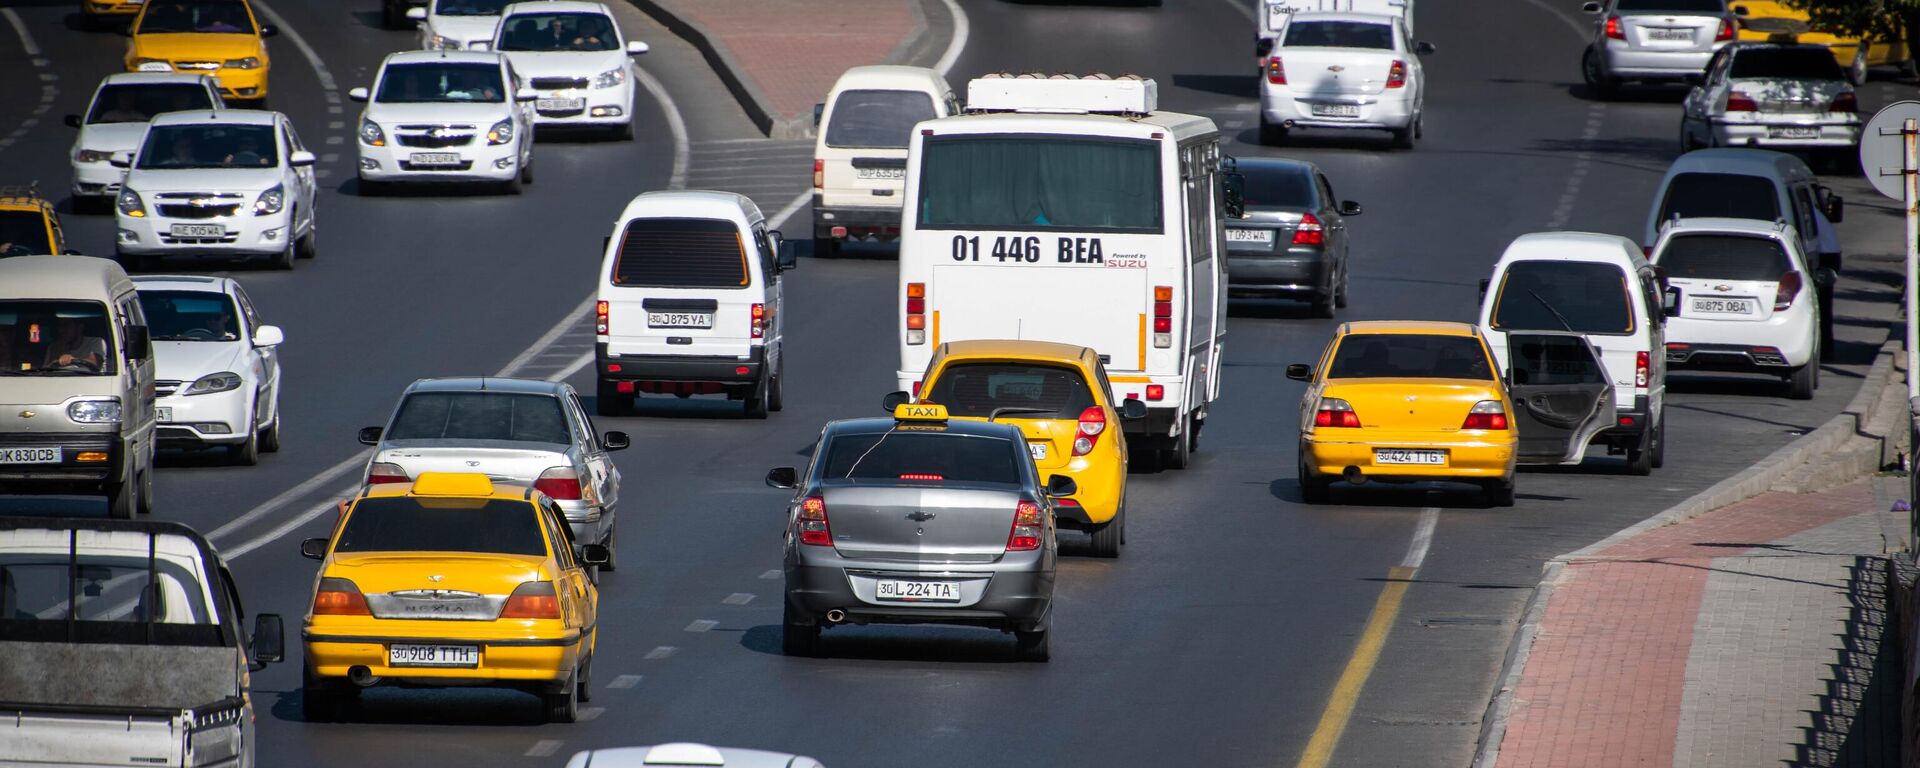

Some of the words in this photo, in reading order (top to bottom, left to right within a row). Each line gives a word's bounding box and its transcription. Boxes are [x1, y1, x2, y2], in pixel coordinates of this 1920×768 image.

[953, 234, 980, 262] 01
[992, 235, 1040, 263] 446
[1058, 237, 1104, 264] BEA
[1104, 260, 1148, 268] ISUZU
[1705, 301, 1724, 311] 875
[651, 315, 661, 323] 30
[671, 315, 689, 325] 875
[691, 315, 705, 325] YA
[906, 407, 937, 417] TAXI
[1379, 453, 1390, 461] 30
[1391, 451, 1411, 462] 424
[1415, 451, 1438, 463] TTG
[880, 583, 893, 594] 30
[906, 583, 931, 596] 224
[933, 584, 951, 597] TA
[394, 647, 407, 659] 30
[409, 646, 436, 661] 908
[440, 646, 470, 661] TTH
